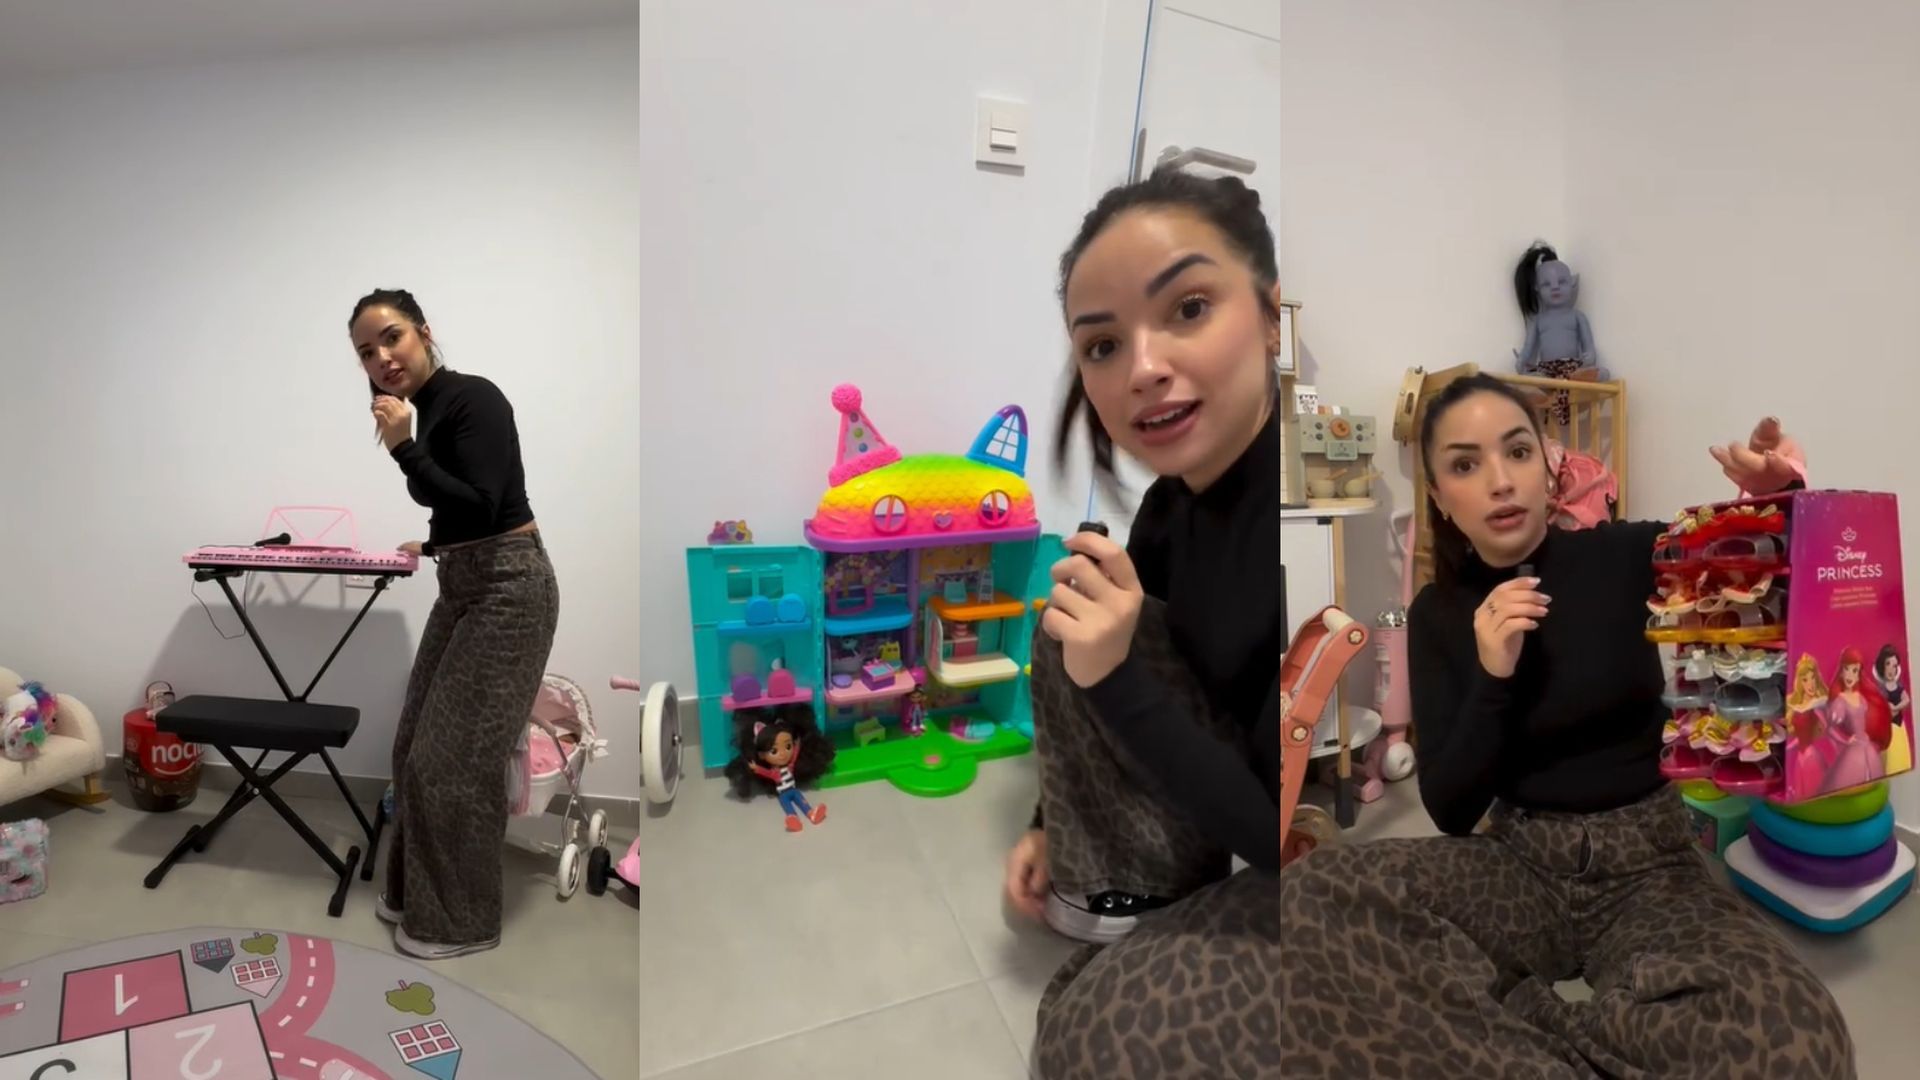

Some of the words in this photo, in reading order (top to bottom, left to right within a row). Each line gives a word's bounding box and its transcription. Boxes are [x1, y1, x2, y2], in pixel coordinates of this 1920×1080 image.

[1833, 545, 1867, 563] Disney
[1817, 564, 1883, 582] PRINCESS
[115, 974, 139, 1016] 1
[175, 1024, 223, 1080] 2
